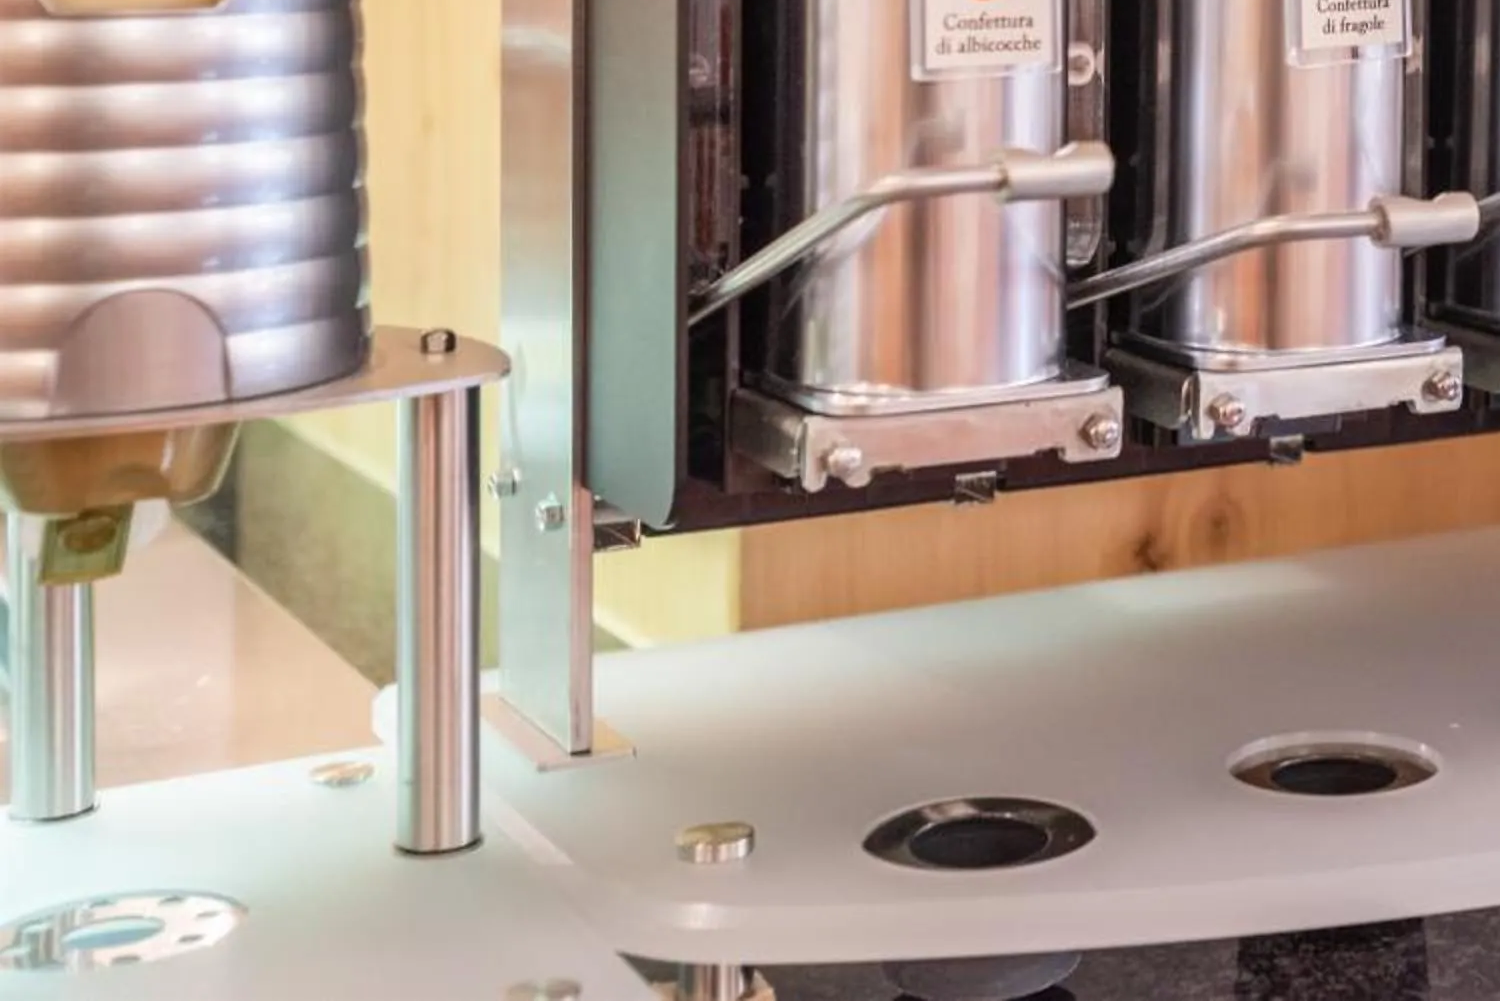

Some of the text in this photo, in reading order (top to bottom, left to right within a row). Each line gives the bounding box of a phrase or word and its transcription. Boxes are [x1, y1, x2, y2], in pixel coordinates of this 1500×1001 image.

[942, 12, 1034, 31] Confettura
[1322, 14, 1385, 36] di fragole
[936, 33, 1041, 55] di albicocche
